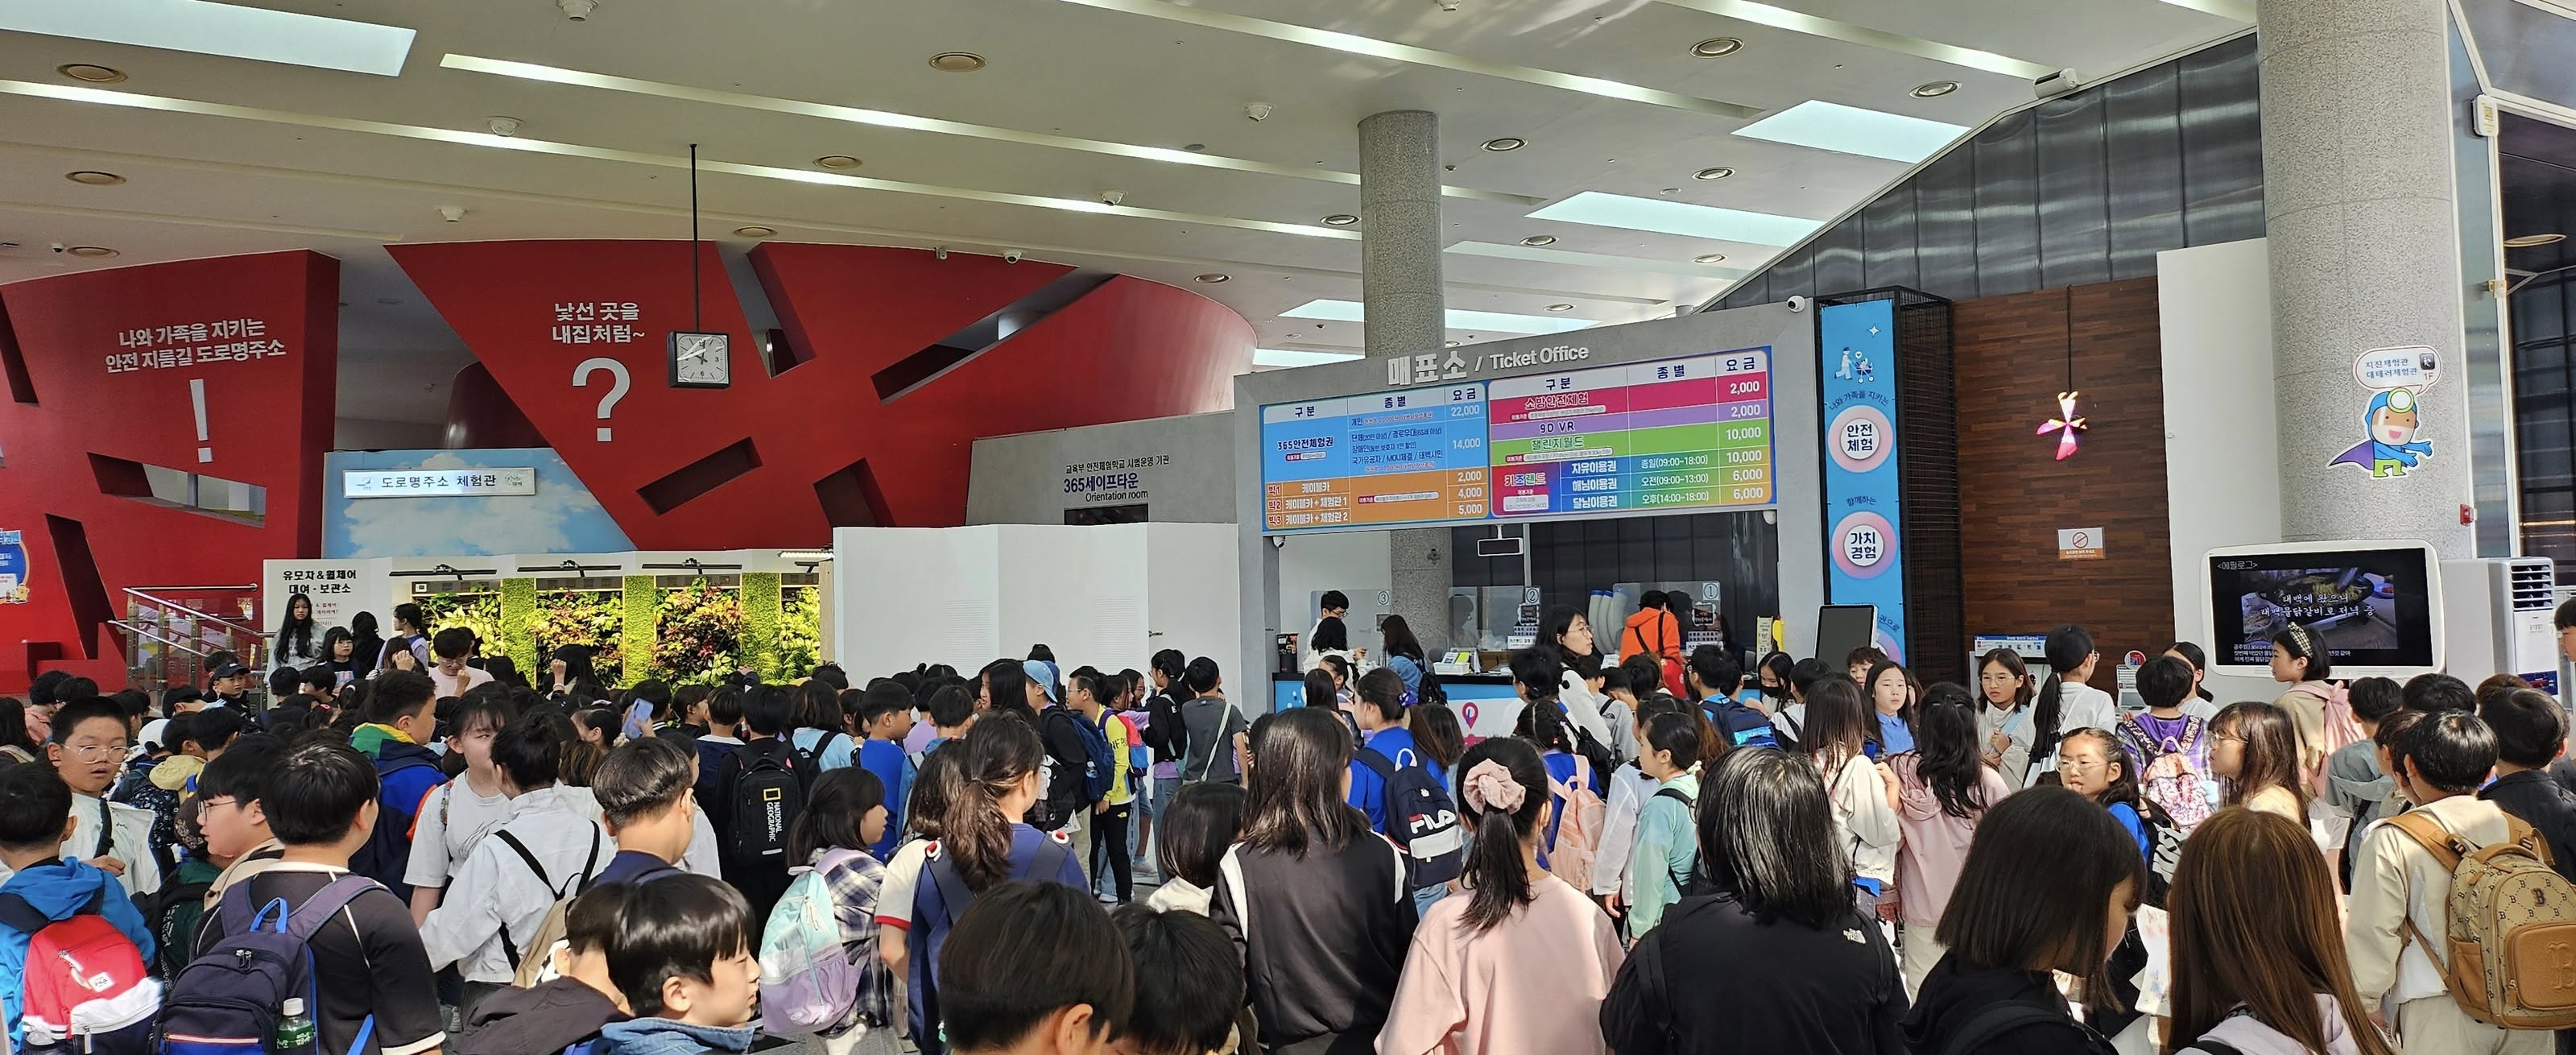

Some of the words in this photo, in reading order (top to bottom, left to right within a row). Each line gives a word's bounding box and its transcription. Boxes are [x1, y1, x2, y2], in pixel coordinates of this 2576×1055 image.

[554, 302, 594, 321] 낯선
[599, 302, 639, 321] 곳을
[119, 329, 154, 348] 나와
[156, 324, 208, 345] 가족을
[212, 318, 266, 339] 지키는
[105, 354, 139, 374] 안전
[142, 346, 193, 369] 지름길
[196, 340, 287, 363] 도로명주소
[2365, 358, 2409, 369] 지진체험관
[1387, 350, 1468, 386] 매표소
[1490, 350, 1537, 370] Ticket
[1539, 345, 1590, 364] Office
[2366, 367, 2417, 379] 대테러체험관
[2424, 372, 2433, 380] 1F
[1730, 381, 1759, 395] 2,000
[1525, 392, 1589, 410] 소방안전체험
[1829, 398, 1844, 410] 나와
[1844, 391, 1867, 401] 가족을
[1868, 391, 1889, 406] 지키는
[1450, 405, 1480, 417] 22,000
[1731, 405, 1760, 418] 2,000
[1351, 417, 1362, 426] 개인
[1540, 423, 1554, 434] 9D
[1559, 421, 1574, 432] VR
[1726, 428, 1761, 441] 10,000
[1847, 424, 1872, 437] 안전
[1277, 436, 1333, 451] 365안전체험권
[1453, 437, 1481, 450] 14,000
[1532, 435, 1585, 452] 챌린지월드
[1847, 438, 1872, 451] 체험
[1726, 450, 1762, 464] 10,000
[1065, 464, 1085, 474] 교육부
[1086, 459, 1125, 472] 안전체험학교
[1127, 456, 1154, 468] 시범운영
[1156, 454, 1169, 465] 기관
[1571, 460, 1617, 474] 자유이용권
[382, 476, 449, 488] 도로명주소
[457, 474, 497, 487] 체험관
[1458, 471, 1482, 482] 2,000
[1503, 472, 1546, 487] 키즈랜드
[1733, 470, 1763, 482] 6,000
[1064, 473, 1139, 493] 365세이프타운
[1268, 485, 1281, 495] 빅1
[1301, 482, 1330, 494] 케이블카
[1572, 478, 1617, 492] 해님이용권
[1085, 491, 1127, 502] Orientation
[1128, 490, 1148, 499] room
[1458, 487, 1482, 498] 4,000
[1734, 487, 1763, 499] 6,000
[1268, 500, 1281, 511] 빅2
[1285, 499, 1313, 510] 케이블카
[1320, 498, 1342, 508] 체험관
[1573, 494, 1617, 509] 달님이용권
[1846, 496, 1876, 507] 함께하는
[1458, 503, 1482, 515] 5,000
[1268, 515, 1282, 525] 빅3
[1285, 515, 1313, 525] 케이블카
[1320, 513, 1342, 523] 체험관
[1850, 532, 1875, 544] 가치
[1851, 546, 1876, 559] 경험
[289, 584, 310, 594] 대여
[320, 583, 351, 594] 보관소
[2282, 593, 2313, 604] 태백에
[2318, 593, 2349, 604] 왔으니
[2338, 606, 2359, 617] 저녁
[2363, 605, 2375, 617] 중
[767, 802, 776, 842] GEOGRAPHIC
[774, 801, 783, 834] NATIONAL
[1409, 809, 1456, 834] FILA
[2533, 888, 2545, 906] B
